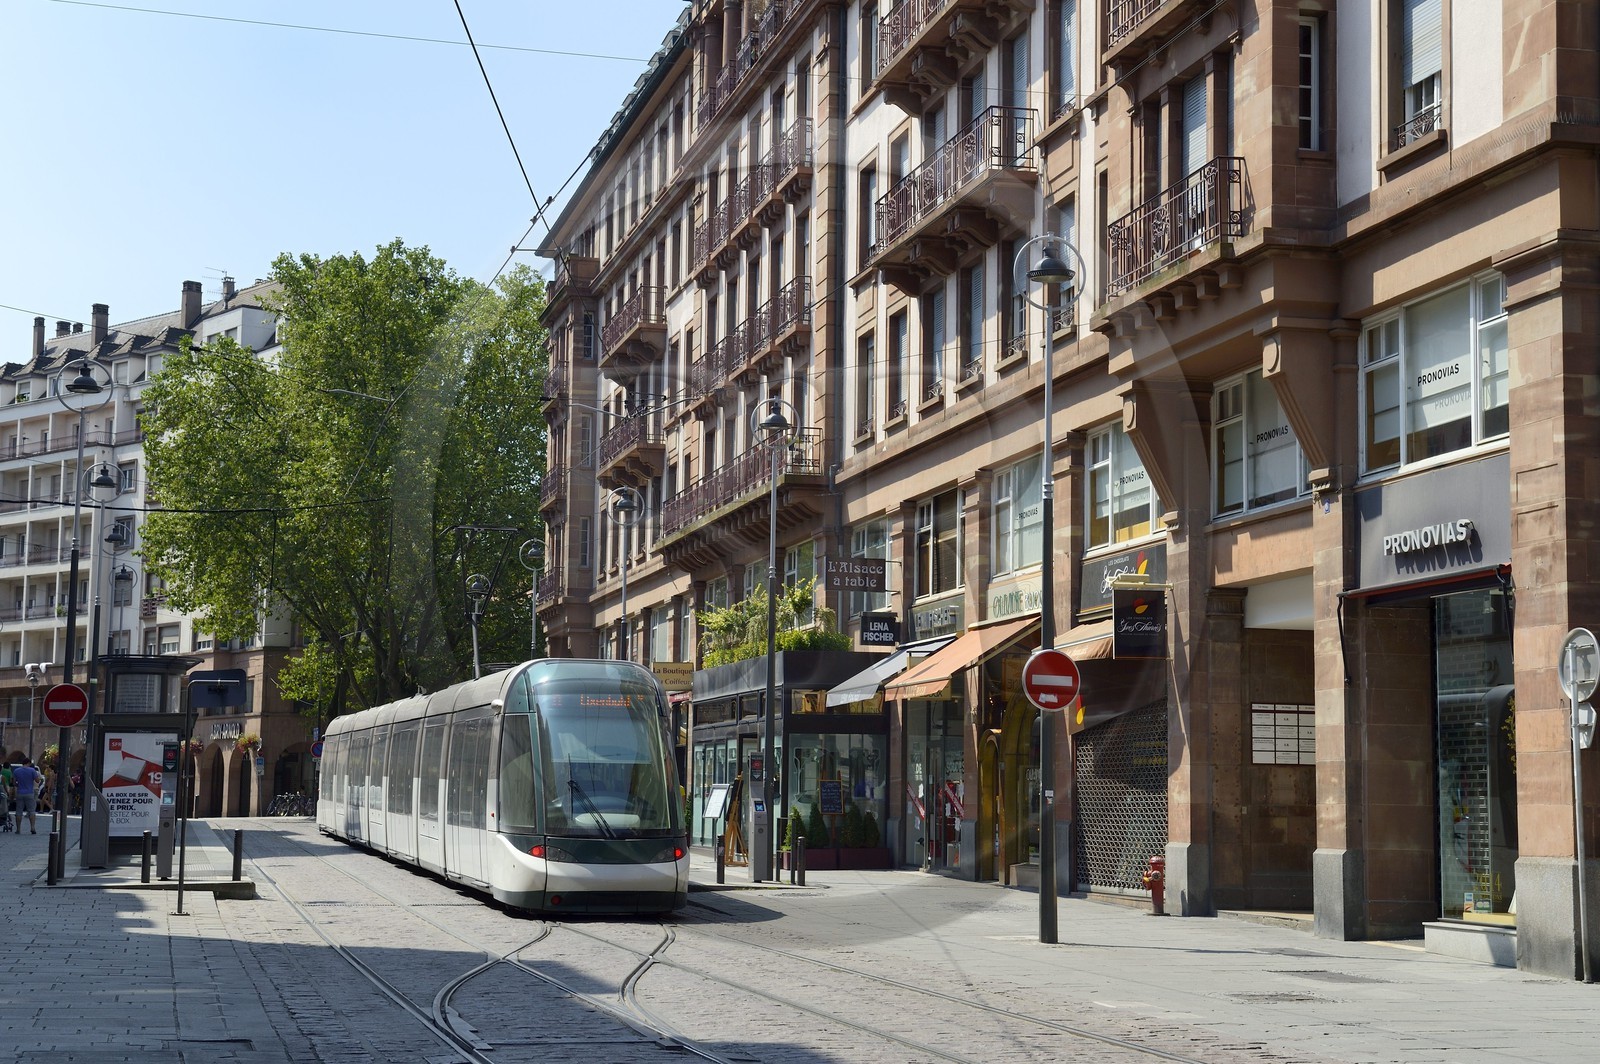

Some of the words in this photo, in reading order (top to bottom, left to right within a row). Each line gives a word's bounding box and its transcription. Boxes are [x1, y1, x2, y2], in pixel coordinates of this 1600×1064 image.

[1417, 363, 1460, 387] PRONOVIAS
[1256, 425, 1289, 444] PRONOVIAS
[1119, 470, 1145, 486] PRONOVIAS
[1383, 518, 1471, 556] PRONOVIAS
[828, 561, 883, 574] L'Alsace
[833, 576, 840, 586] à
[845, 576, 877, 587] table
[869, 622, 889, 631] LENA
[863, 632, 894, 642] FISCHER
[662, 667, 693, 676] Boutique
